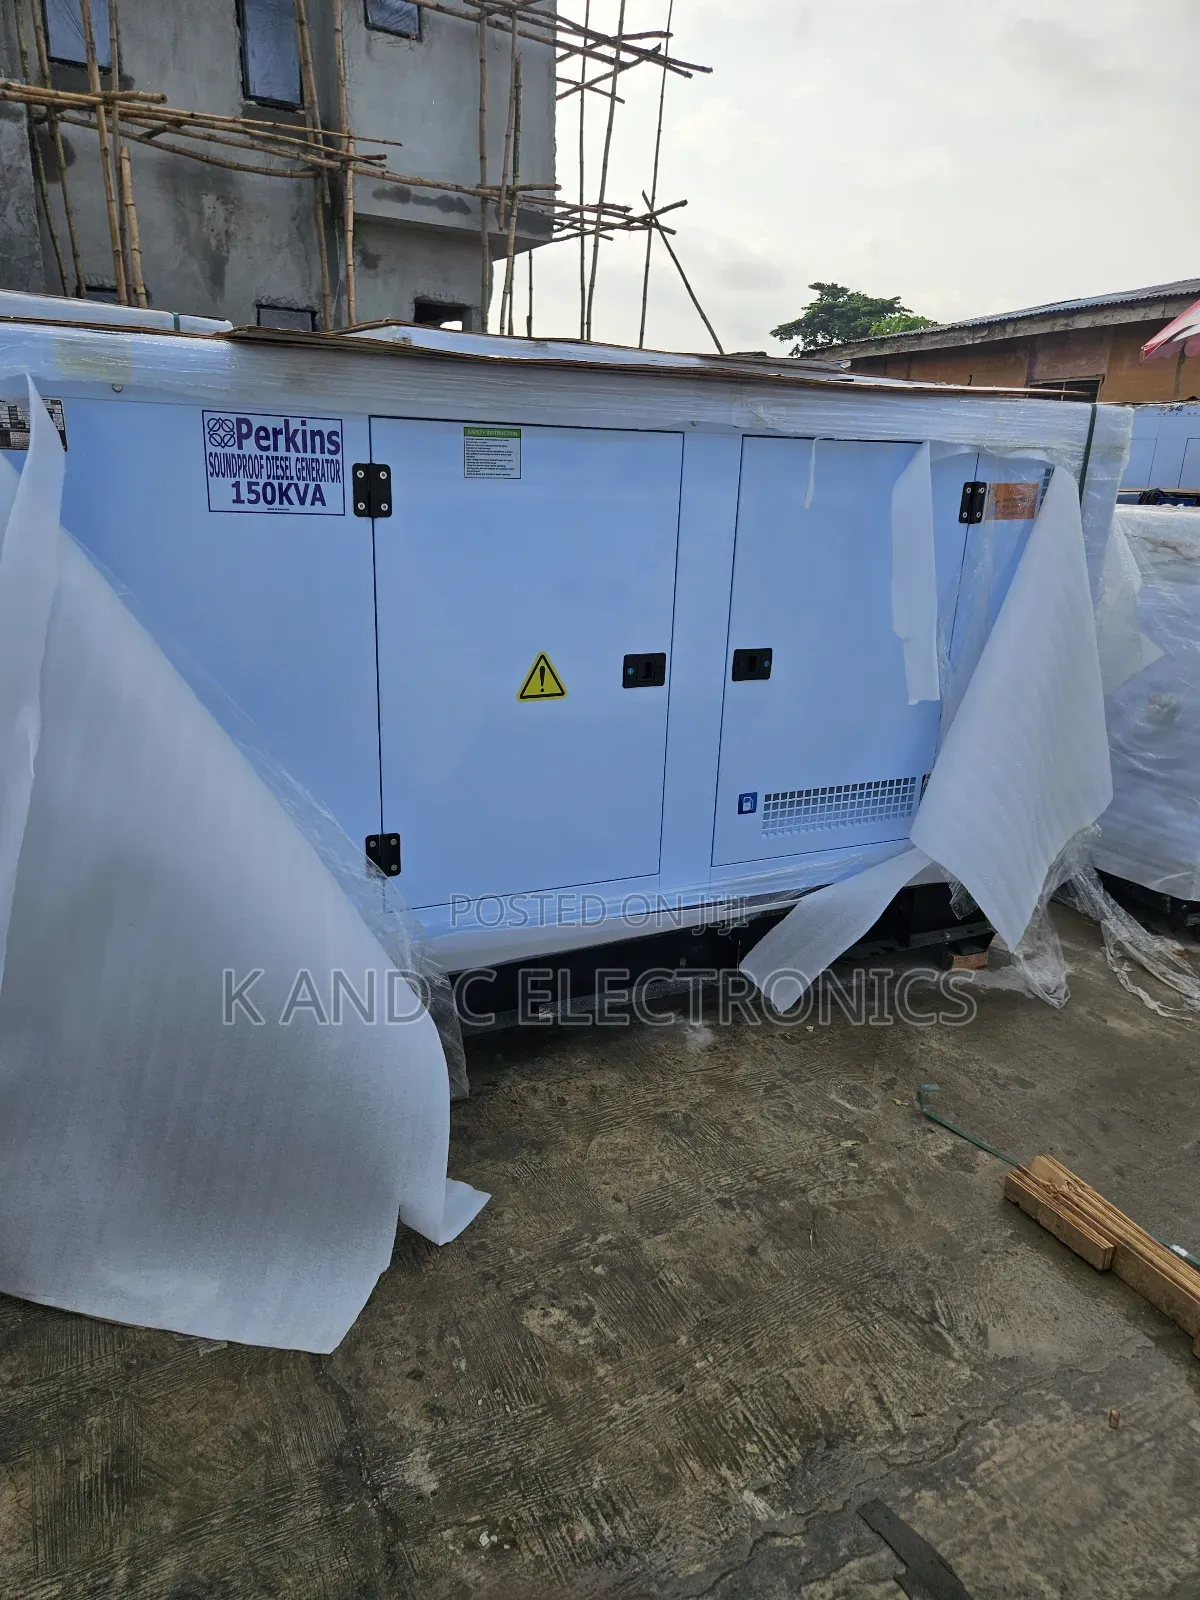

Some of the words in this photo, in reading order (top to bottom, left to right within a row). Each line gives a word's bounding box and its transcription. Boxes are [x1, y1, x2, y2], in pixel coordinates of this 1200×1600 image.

[236, 417, 340, 455] Perkins
[208, 452, 263, 479] SOUNDPROOF
[266, 456, 294, 481] DIESEL
[295, 457, 341, 483] GENERATOR
[231, 480, 327, 507] 150KVA
